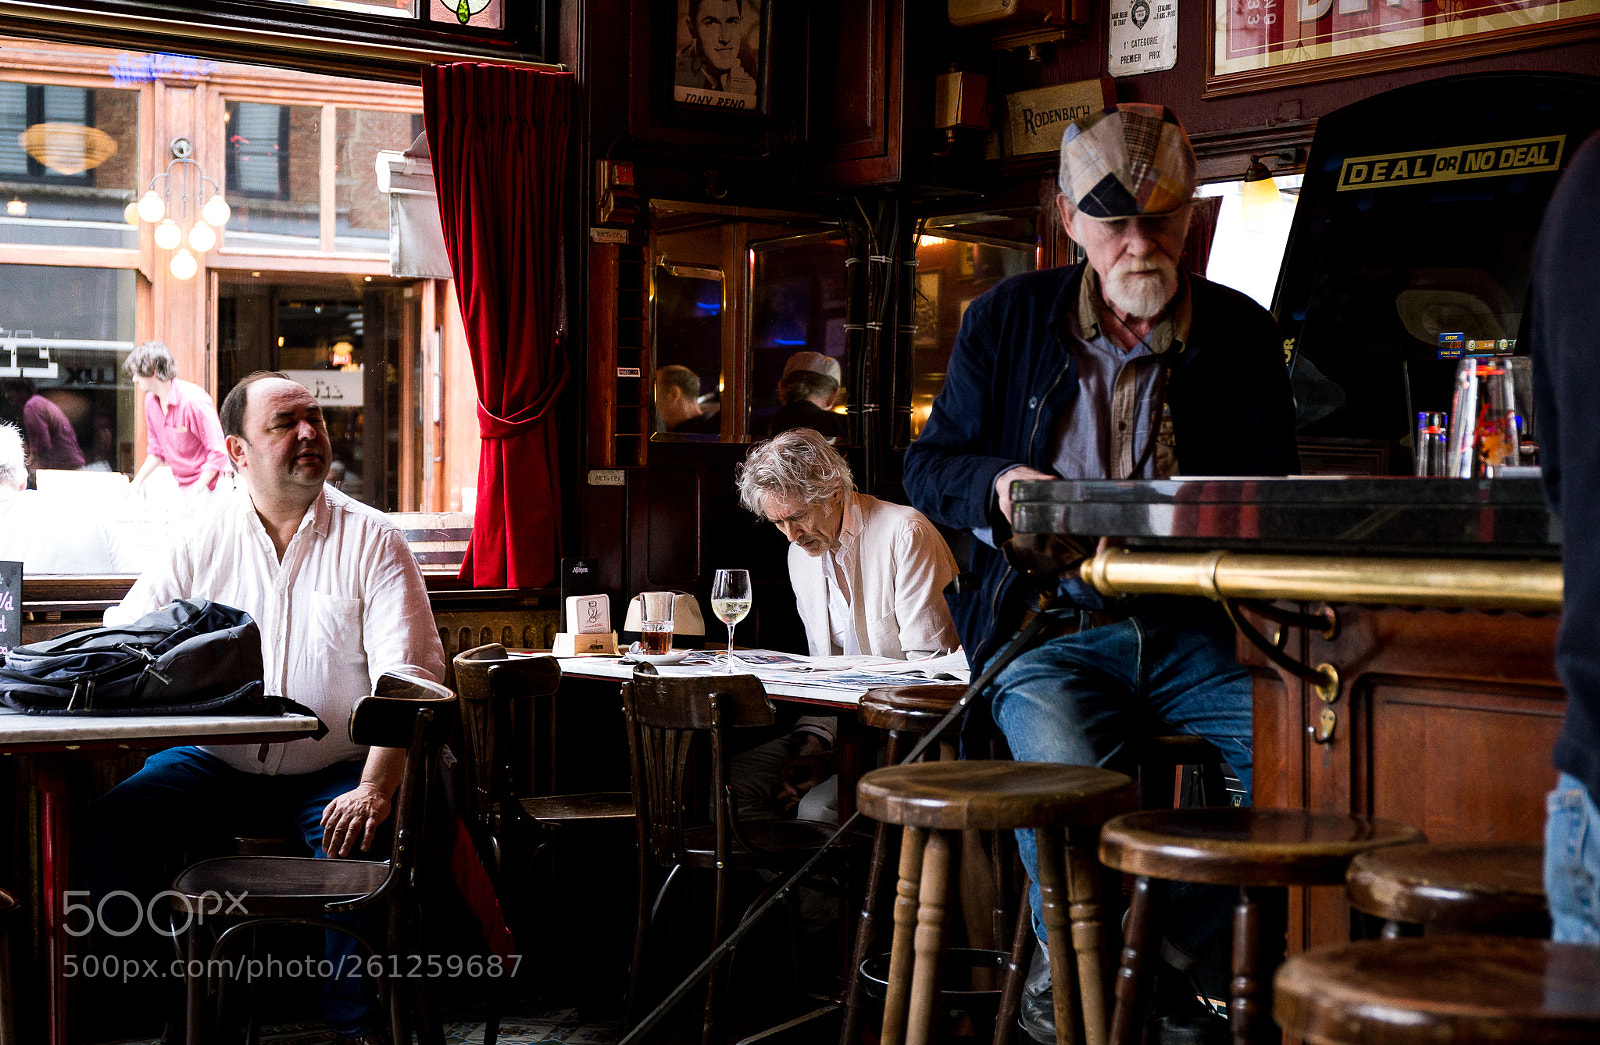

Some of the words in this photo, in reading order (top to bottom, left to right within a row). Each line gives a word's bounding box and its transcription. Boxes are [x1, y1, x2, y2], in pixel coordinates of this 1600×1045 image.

[1120, 54, 1141, 64] PREMIER
[1148, 51, 1160, 60] PRIX
[685, 92, 713, 105] TONY
[716, 97, 746, 109] RENO
[1349, 158, 1428, 184] DEAL
[1435, 155, 1457, 172] OR
[1464, 151, 1496, 172] NO
[1500, 144, 1550, 168] DEAL
